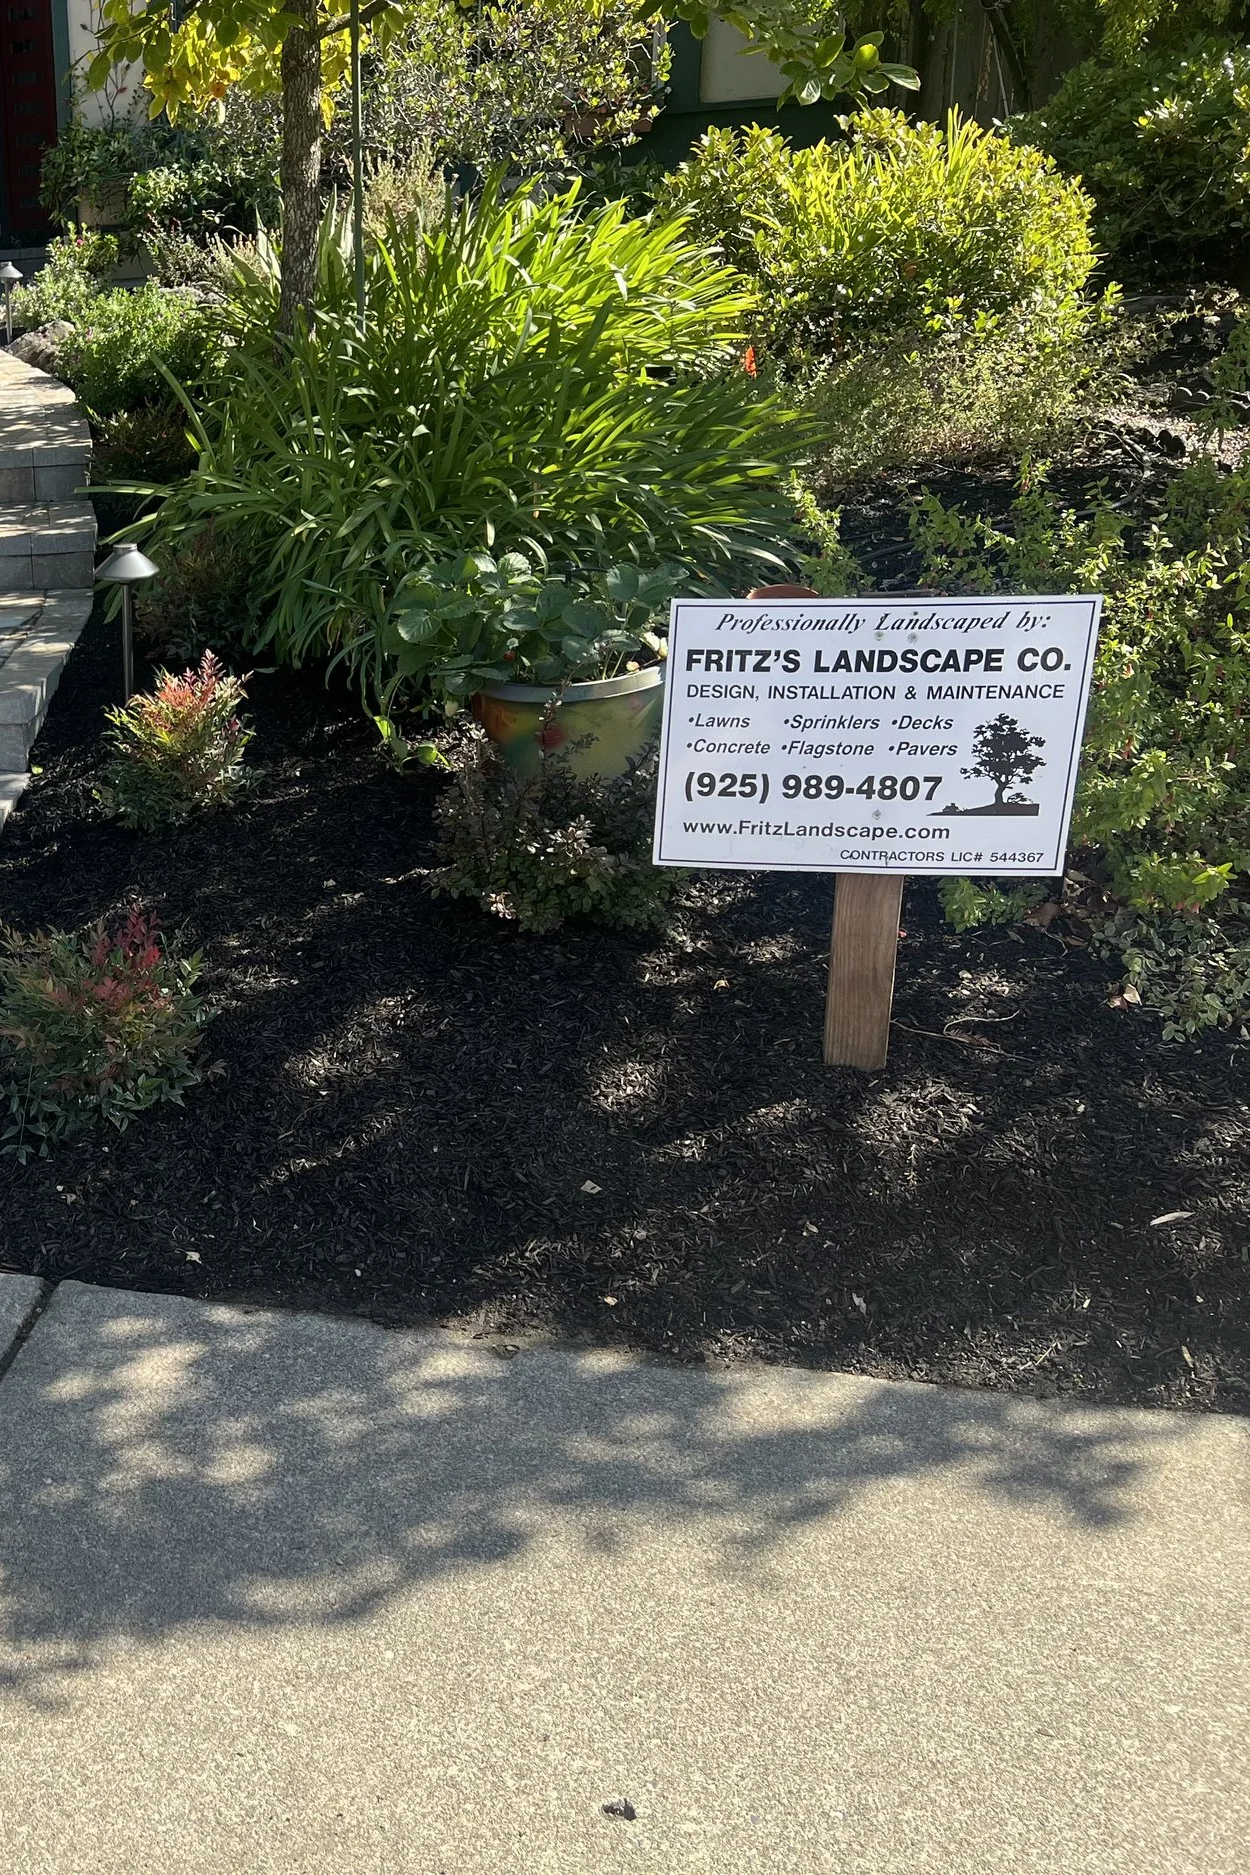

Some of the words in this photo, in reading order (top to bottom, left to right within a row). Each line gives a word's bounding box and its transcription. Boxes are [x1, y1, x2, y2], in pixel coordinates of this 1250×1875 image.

[715, 613, 866, 634] Professionally
[874, 611, 1011, 634] Landscaped
[1016, 611, 1051, 632] by:
[686, 649, 800, 673] FRITZ'S
[814, 649, 1004, 673] LANDSCAPE
[1017, 647, 1071, 672] CO.
[687, 685, 758, 701] DESIGN,
[768, 686, 896, 700] INSTALLATION
[905, 686, 916, 700] &
[927, 684, 1065, 699] MAINTENANCE
[685, 772, 769, 803] (925)
[782, 775, 942, 800] 989-4807
[683, 819, 949, 840] www.FritzLandscape.com
[840, 850, 944, 862] CONTRACTORS
[951, 852, 983, 862] LIC#
[990, 853, 1044, 862] 544367
